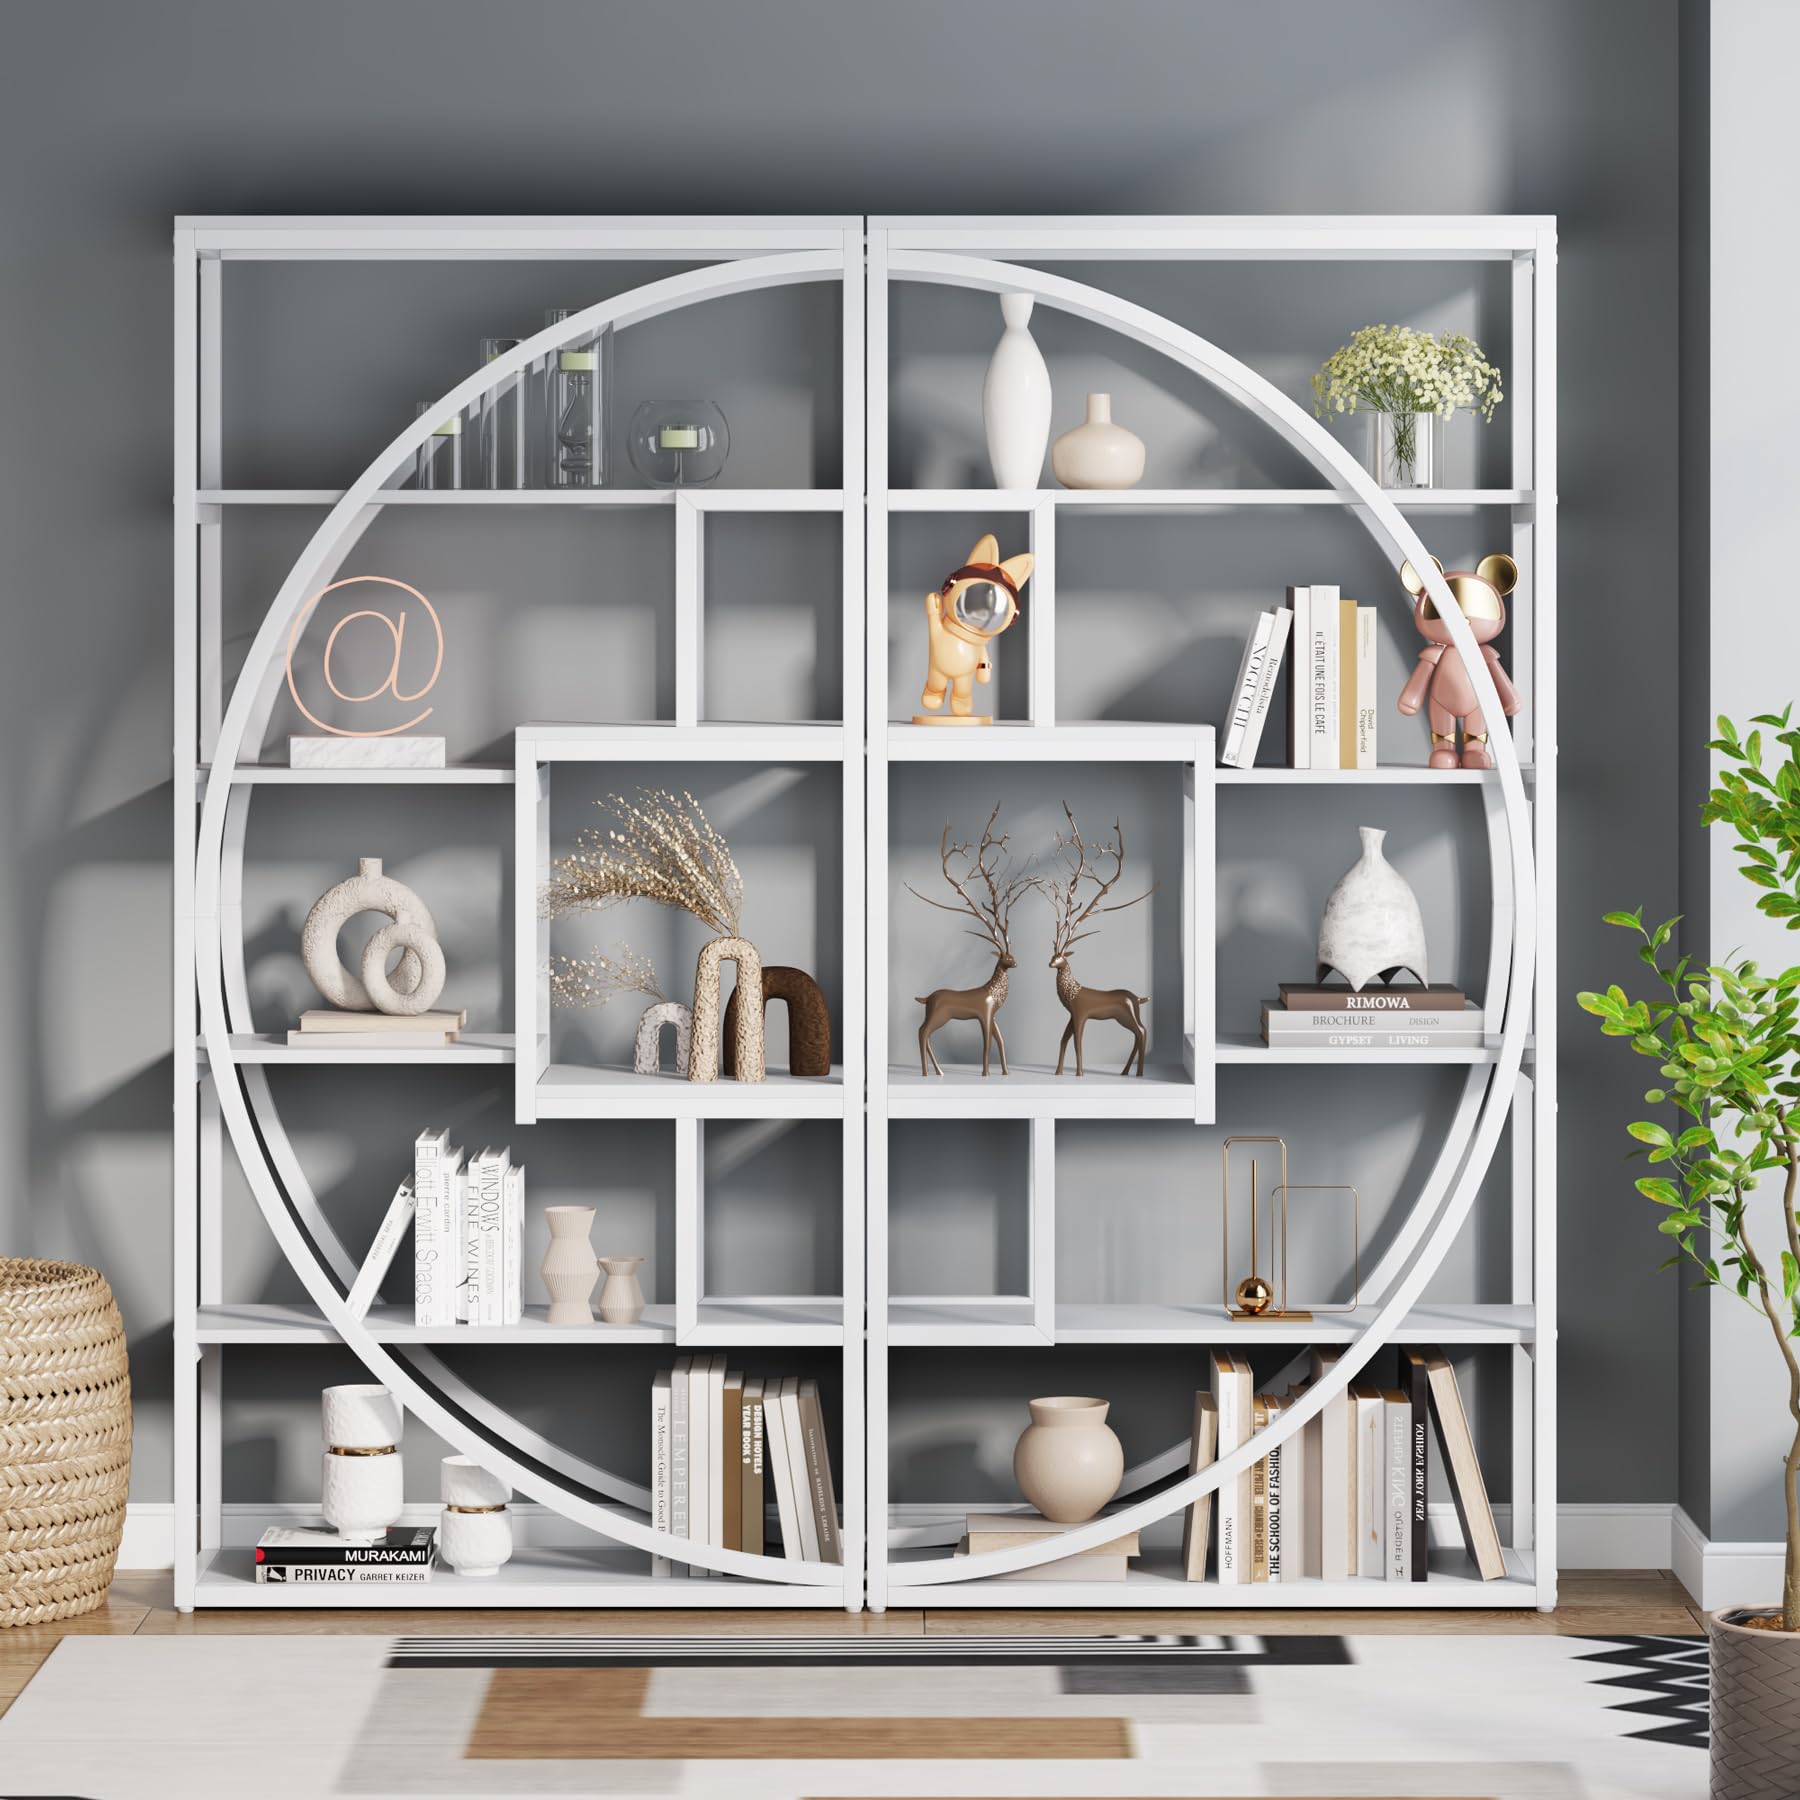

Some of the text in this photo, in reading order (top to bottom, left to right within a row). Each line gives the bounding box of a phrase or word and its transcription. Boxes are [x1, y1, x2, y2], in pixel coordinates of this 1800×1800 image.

[1233, 642, 1267, 728] NOGUCHI
[1314, 664, 1326, 681] UNE
[1255, 658, 1278, 714] Remodelista
[1314, 682, 1326, 701] FOIS
[1314, 702, 1326, 713] LE
[1367, 709, 1375, 730] David
[1359, 709, 1368, 753] Chipperfield
[1346, 996, 1410, 1009] RIMOWA
[1312, 1015, 1376, 1026] BROCHURE
[1328, 1035, 1429, 1045] GYPSET LIVING
[415, 1146, 438, 1190] Elliott
[442, 1173, 450, 1201] pierre
[480, 1164, 500, 1232] WINDOWS
[415, 1196, 438, 1243] Erwitt
[467, 1186, 479, 1304] FINE WINES
[657, 1406, 666, 1423] The
[657, 1425, 666, 1461] Monocle
[742, 1404, 752, 1465] YEAR BOOK 9
[753, 1404, 763, 1475] DESIGN HOTELS
[657, 1462, 666, 1488] Guide
[673, 1420, 688, 1537] LEMPEREU
[1254, 1473, 1264, 1495] POTTER
[657, 1489, 666, 1498] to
[1269, 1491, 1280, 1506] OF
[657, 1499, 666, 1524] Good
[1254, 1505, 1264, 1533] CHAMBER
[1269, 1508, 1280, 1552] SCHOOL
[345, 1550, 425, 1562] MURAKAMI
[1254, 1539, 1264, 1563] SECRETS
[294, 1568, 425, 1581] PRIVACY GARRET KEIZER
[1269, 1554, 1280, 1576] THE
